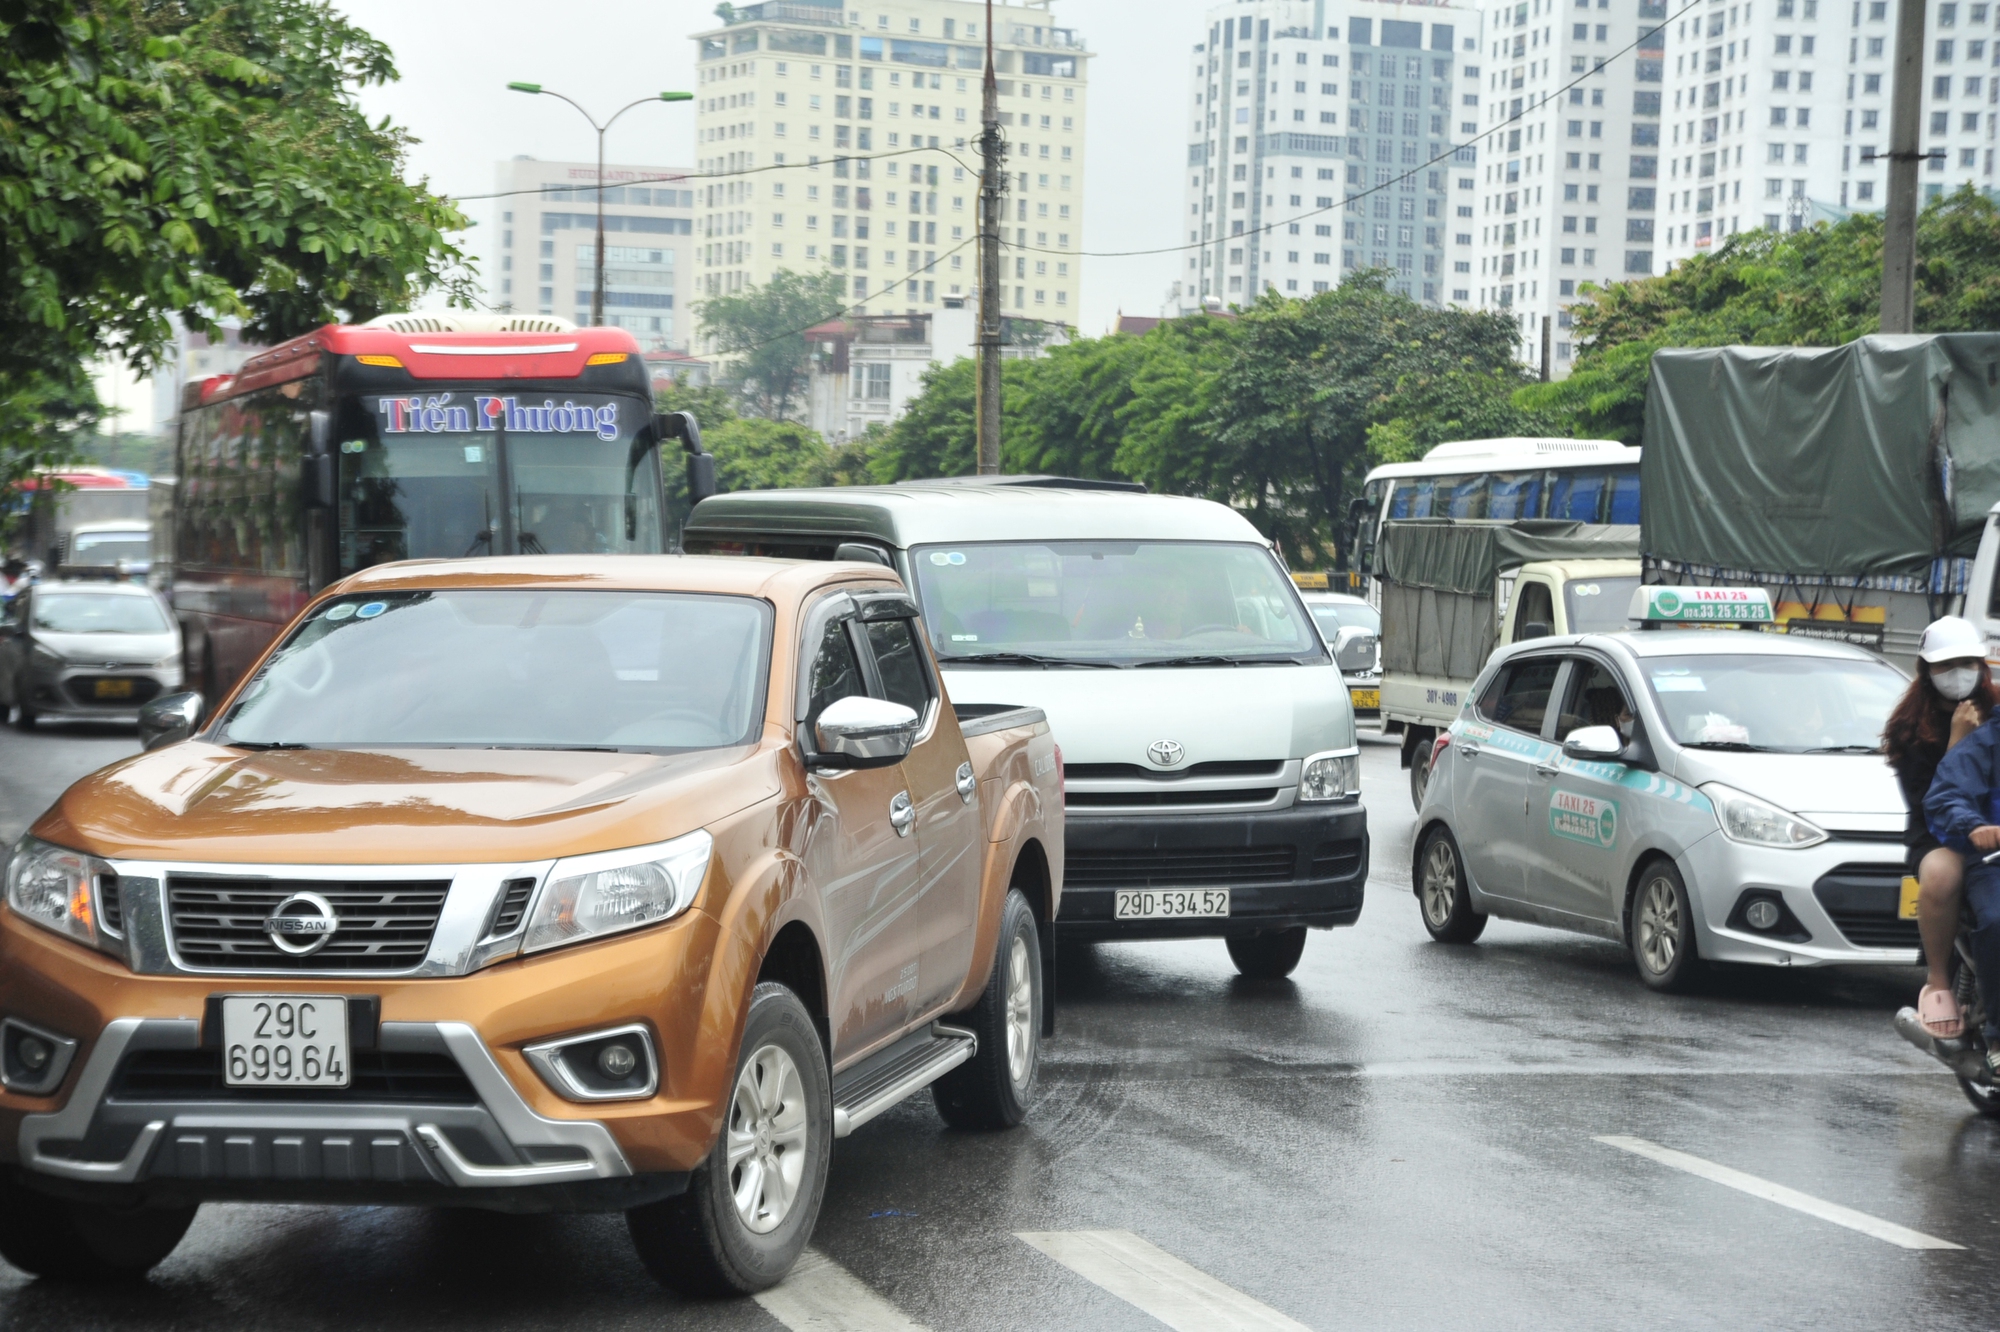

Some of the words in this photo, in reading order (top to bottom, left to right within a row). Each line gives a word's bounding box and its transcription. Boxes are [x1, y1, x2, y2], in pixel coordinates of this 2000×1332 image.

[379, 392, 472, 433] Tiến
[474, 396, 618, 441] Phương
[1696, 591, 1727, 600] TAXI
[1730, 591, 1748, 600] 25
[1683, 604, 1765, 619] 024.33.25.25.25
[1558, 794, 1580, 812] TAXI
[1582, 799, 1595, 815] 25
[1118, 892, 1227, 916] 29D-534.52
[268, 921, 327, 930] NISSAN
[253, 1002, 317, 1040] 29C
[228, 1044, 343, 1083] 699.64
